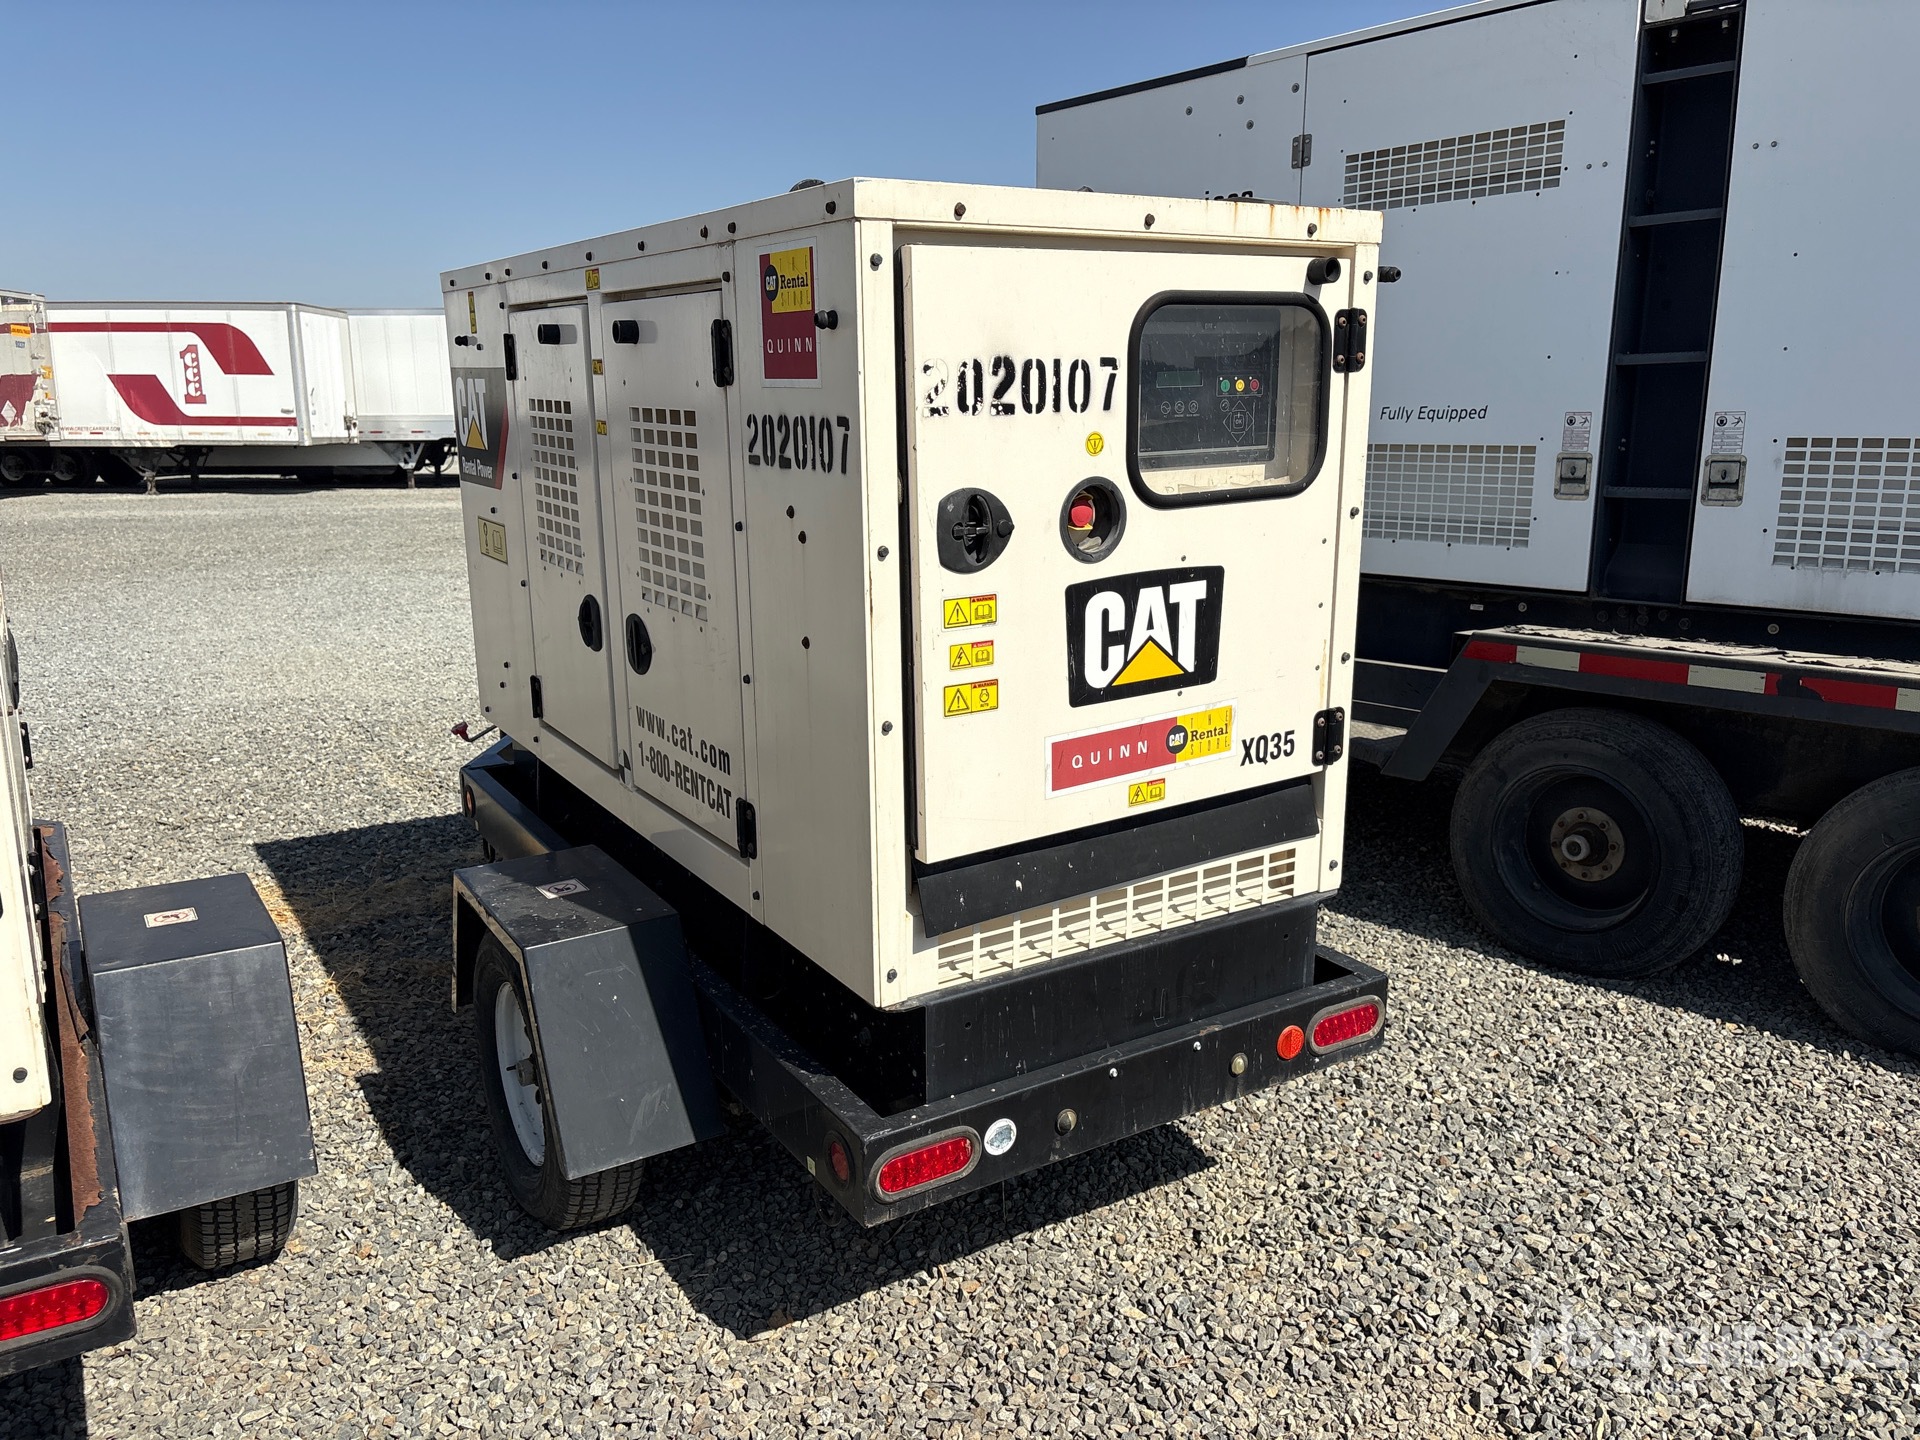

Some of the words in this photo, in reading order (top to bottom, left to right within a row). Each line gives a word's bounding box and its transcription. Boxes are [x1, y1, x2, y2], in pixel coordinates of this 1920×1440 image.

[765, 275, 777, 291] CAT
[780, 272, 809, 290] Rental
[767, 337, 813, 353] QUINN
[923, 355, 1120, 416] 2020107
[455, 376, 489, 450] CAT
[1380, 406, 1414, 423] Fully
[1417, 405, 1488, 423] Equipped
[746, 413, 850, 475] 2020107
[462, 456, 477, 476] Rental
[477, 459, 493, 480] Power
[1084, 580, 1207, 689] CAT
[636, 705, 731, 776] www.cat.com
[1190, 710, 1229, 729] THE
[1071, 740, 1148, 769] QUINN
[1168, 731, 1185, 746] CAT
[1190, 724, 1229, 742] Rental
[1240, 730, 1295, 766] XQ35
[638, 740, 732, 819] 1-800-RENTCAT
